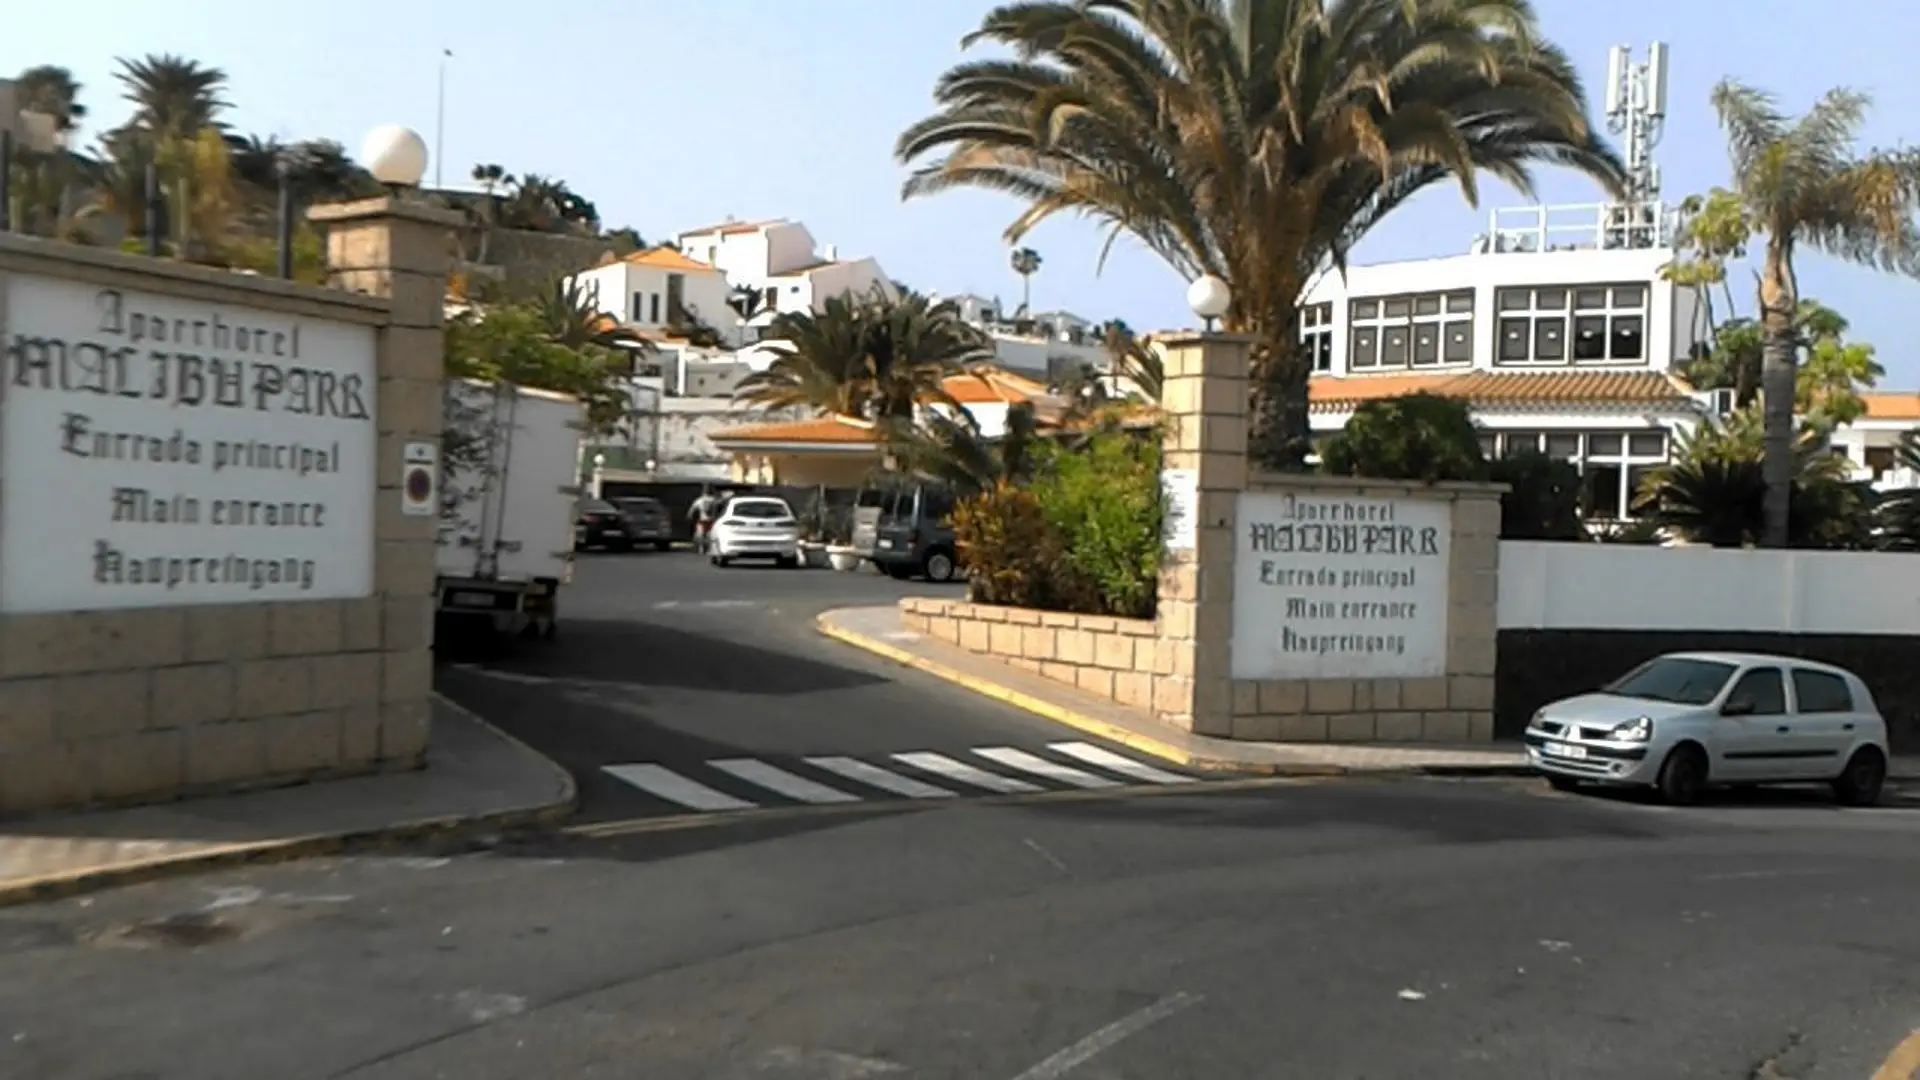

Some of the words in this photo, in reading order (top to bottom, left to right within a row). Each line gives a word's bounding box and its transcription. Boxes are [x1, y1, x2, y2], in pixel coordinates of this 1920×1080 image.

[9, 333, 245, 407] MALIBU
[251, 362, 370, 421] PARK
[60, 412, 201, 463] Entrada
[213, 438, 340, 476] principal
[111, 487, 199, 523] Main
[1250, 522, 1357, 553] MALIBU
[1362, 524, 1439, 555] PARK
[1259, 560, 1336, 586] Entrada
[1342, 566, 1415, 591] principal
[1285, 597, 1335, 619] Main
